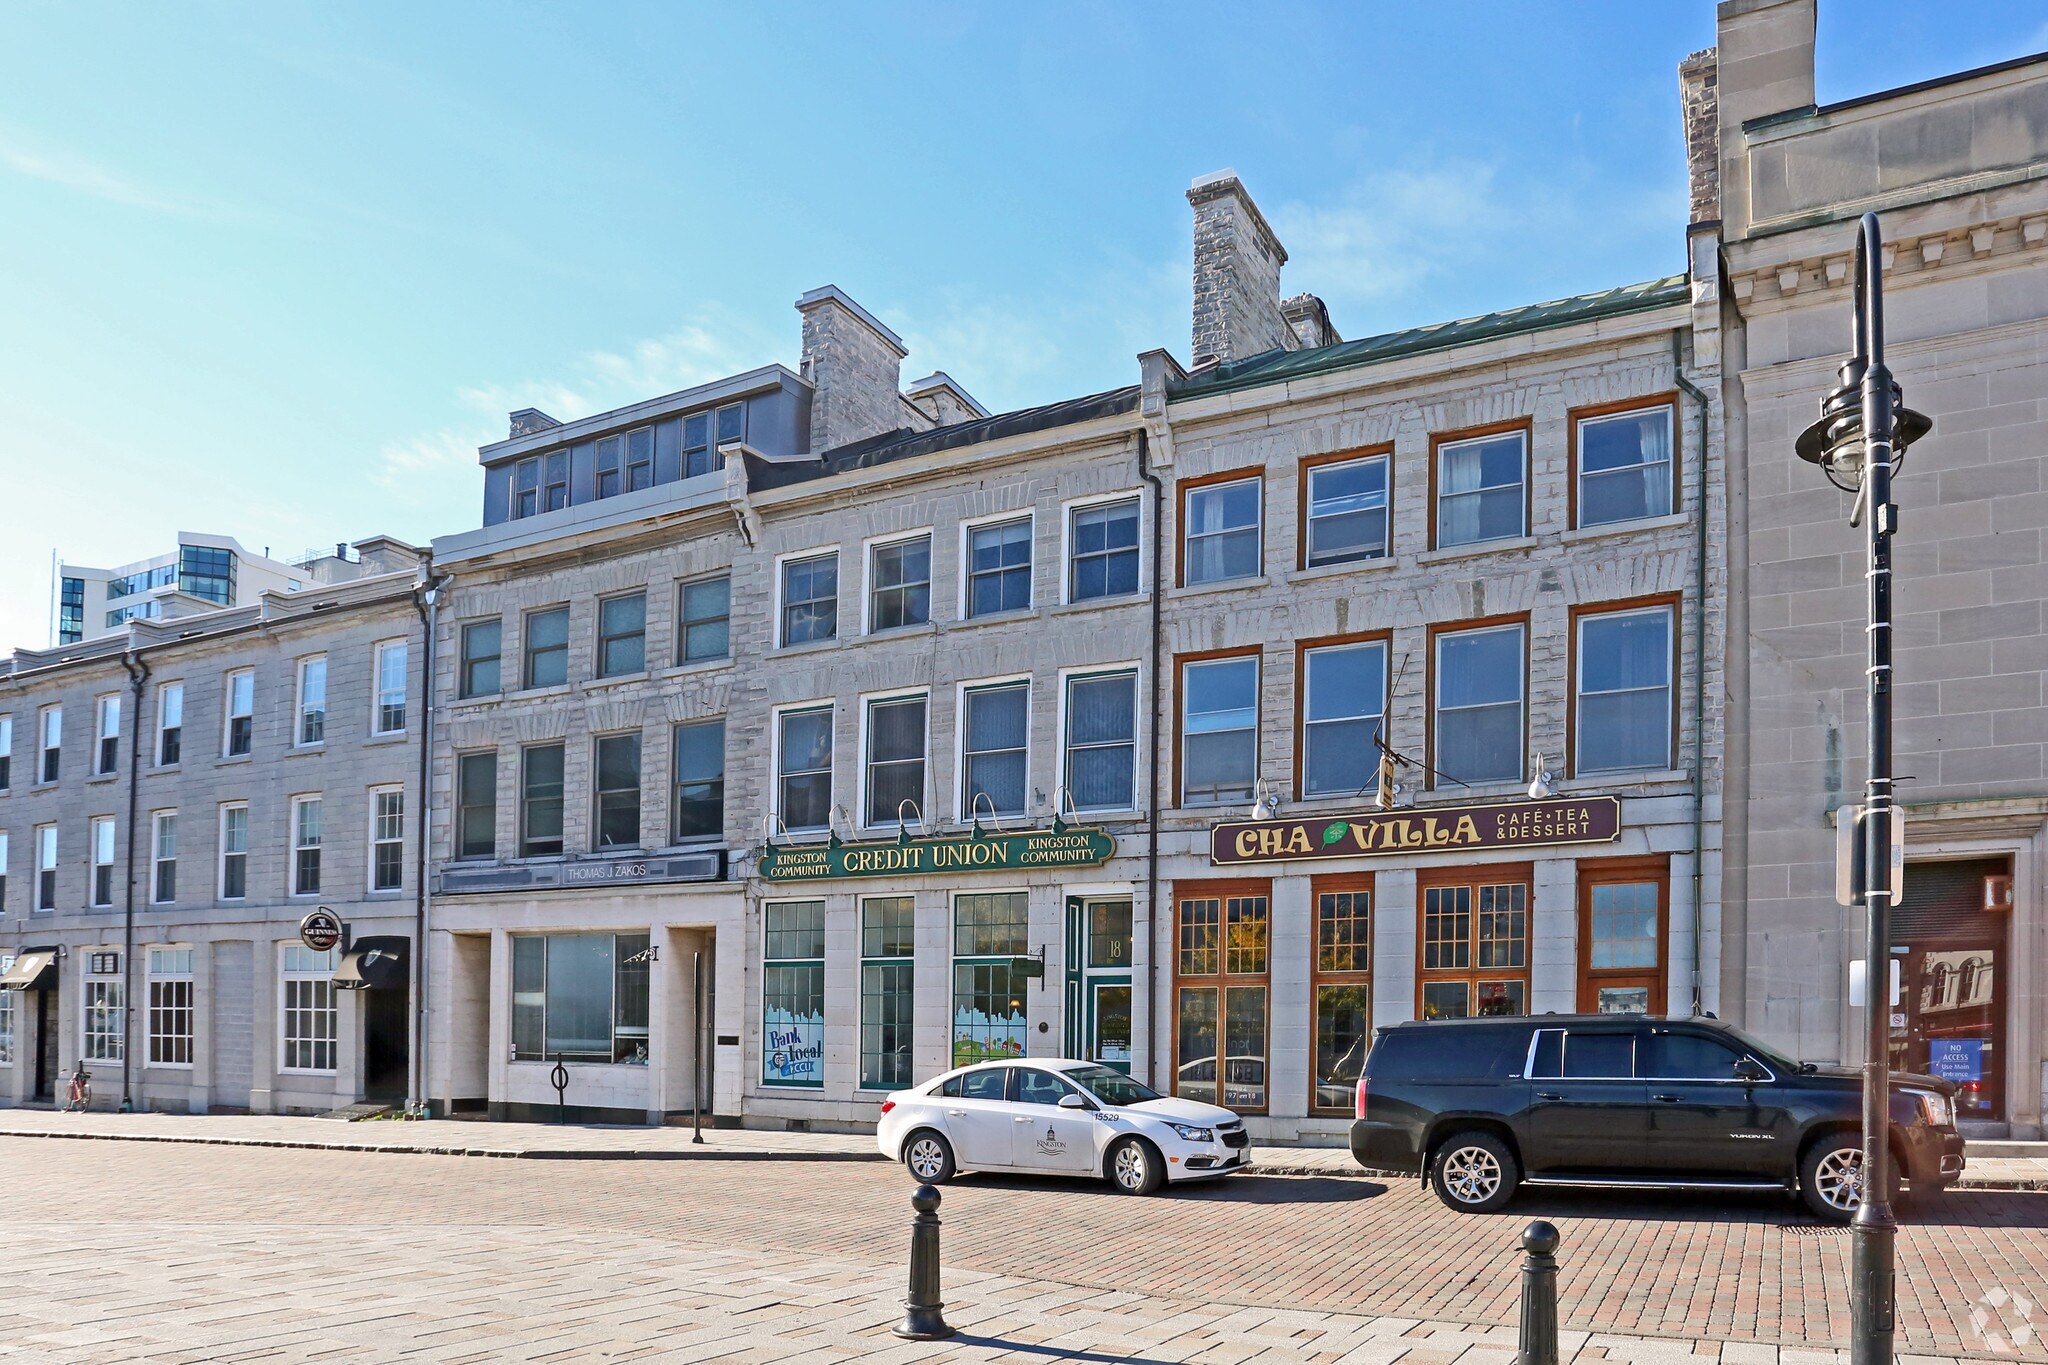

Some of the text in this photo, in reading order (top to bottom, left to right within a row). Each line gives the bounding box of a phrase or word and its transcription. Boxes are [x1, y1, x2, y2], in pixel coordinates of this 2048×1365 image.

[1028, 835, 1089, 850] KINGSTON
[1235, 814, 1482, 857] CHA VILLA
[777, 852, 826, 865] KINGSTON
[843, 841, 1009, 872] CREDIT UNION
[1020, 848, 1096, 863] COMMUNITY
[568, 867, 605, 880] THOMAS
[615, 864, 646, 877] ZAKOS
[770, 864, 832, 877] COMMUNITY
[1109, 940, 1121, 958] 18
[768, 1026, 802, 1050] Bank
[788, 1039, 822, 1062] Local
[1943, 1053, 1969, 1061] ACCESS
[1095, 1113, 1120, 1122] 15529
[1036, 1140, 1066, 1149] KINGSTON
